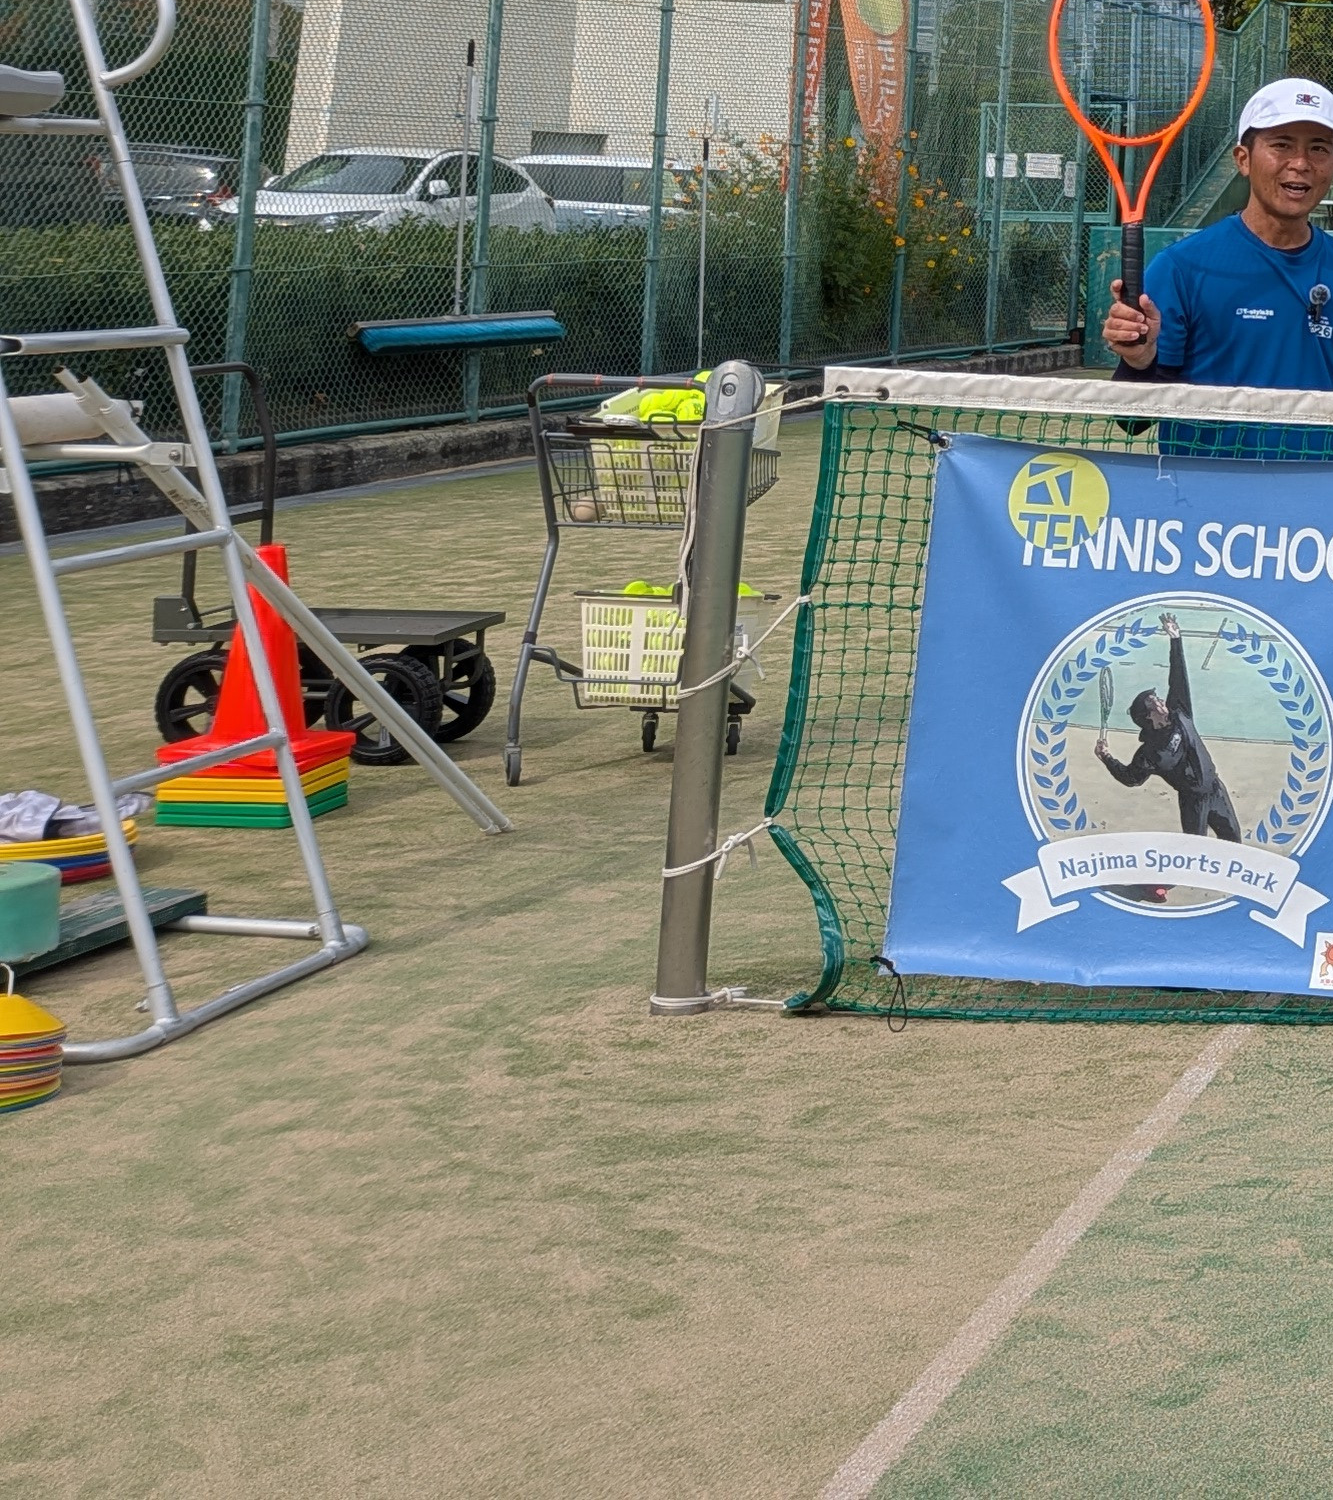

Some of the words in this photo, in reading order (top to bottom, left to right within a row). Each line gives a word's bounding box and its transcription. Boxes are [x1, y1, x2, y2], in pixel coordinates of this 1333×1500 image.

[1018, 512, 1184, 574] TENNIS
[1058, 852, 1137, 880] Najima
[1145, 849, 1221, 873] Sports
[1226, 860, 1279, 893] Park
